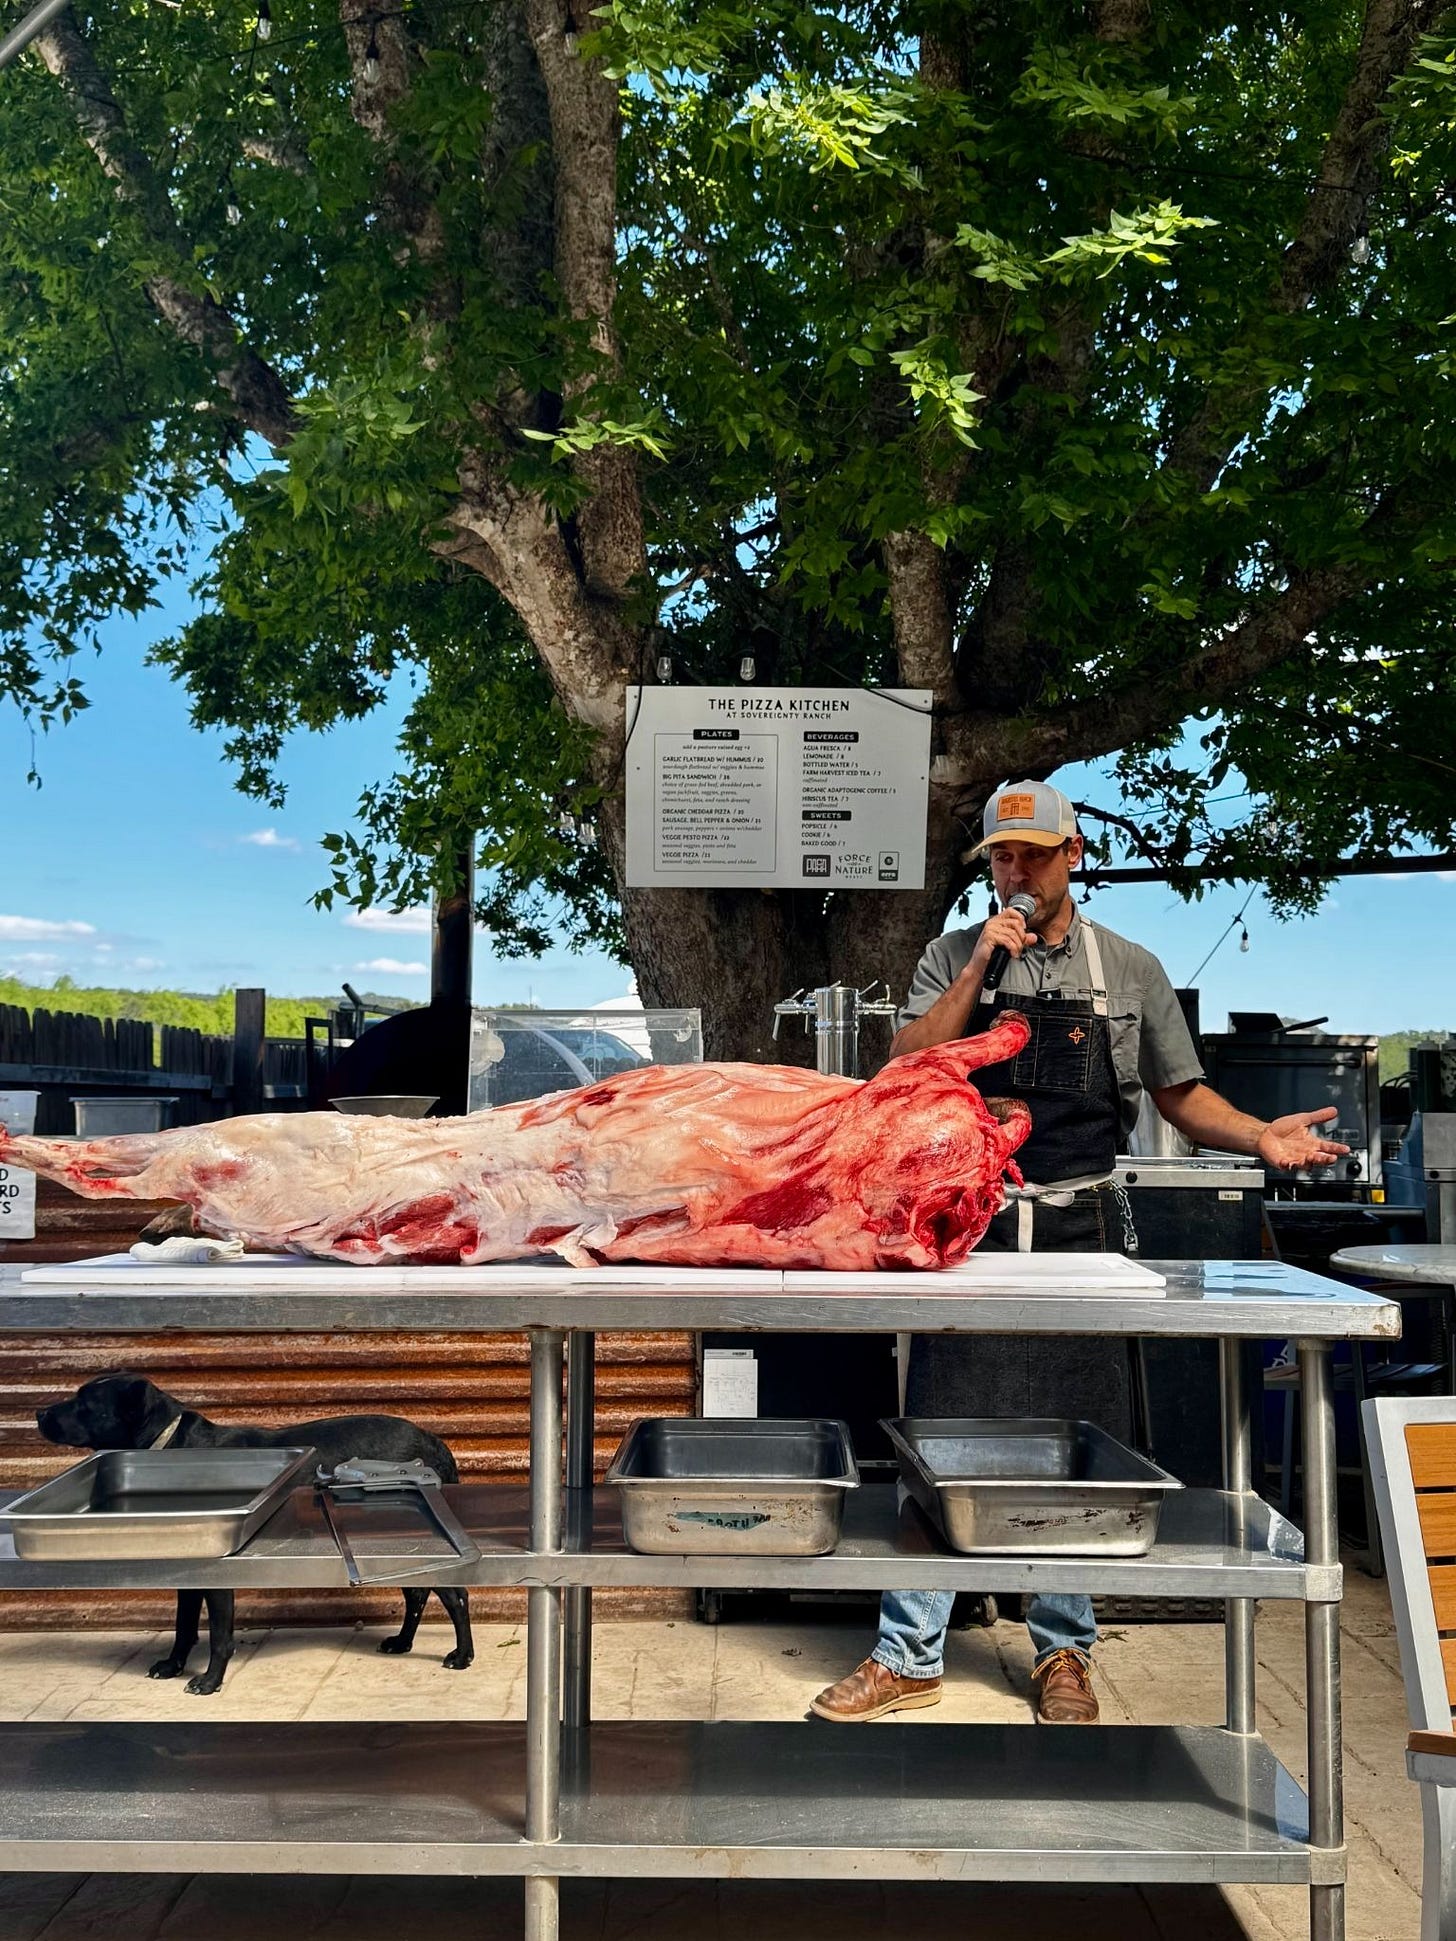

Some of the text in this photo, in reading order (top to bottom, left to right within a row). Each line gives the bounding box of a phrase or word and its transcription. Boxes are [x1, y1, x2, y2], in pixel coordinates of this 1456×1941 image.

[708, 699, 850, 711] THE PIZZA KITCHEN
[838, 854, 872, 863] FORCE
[835, 866, 873, 874] NATURE
